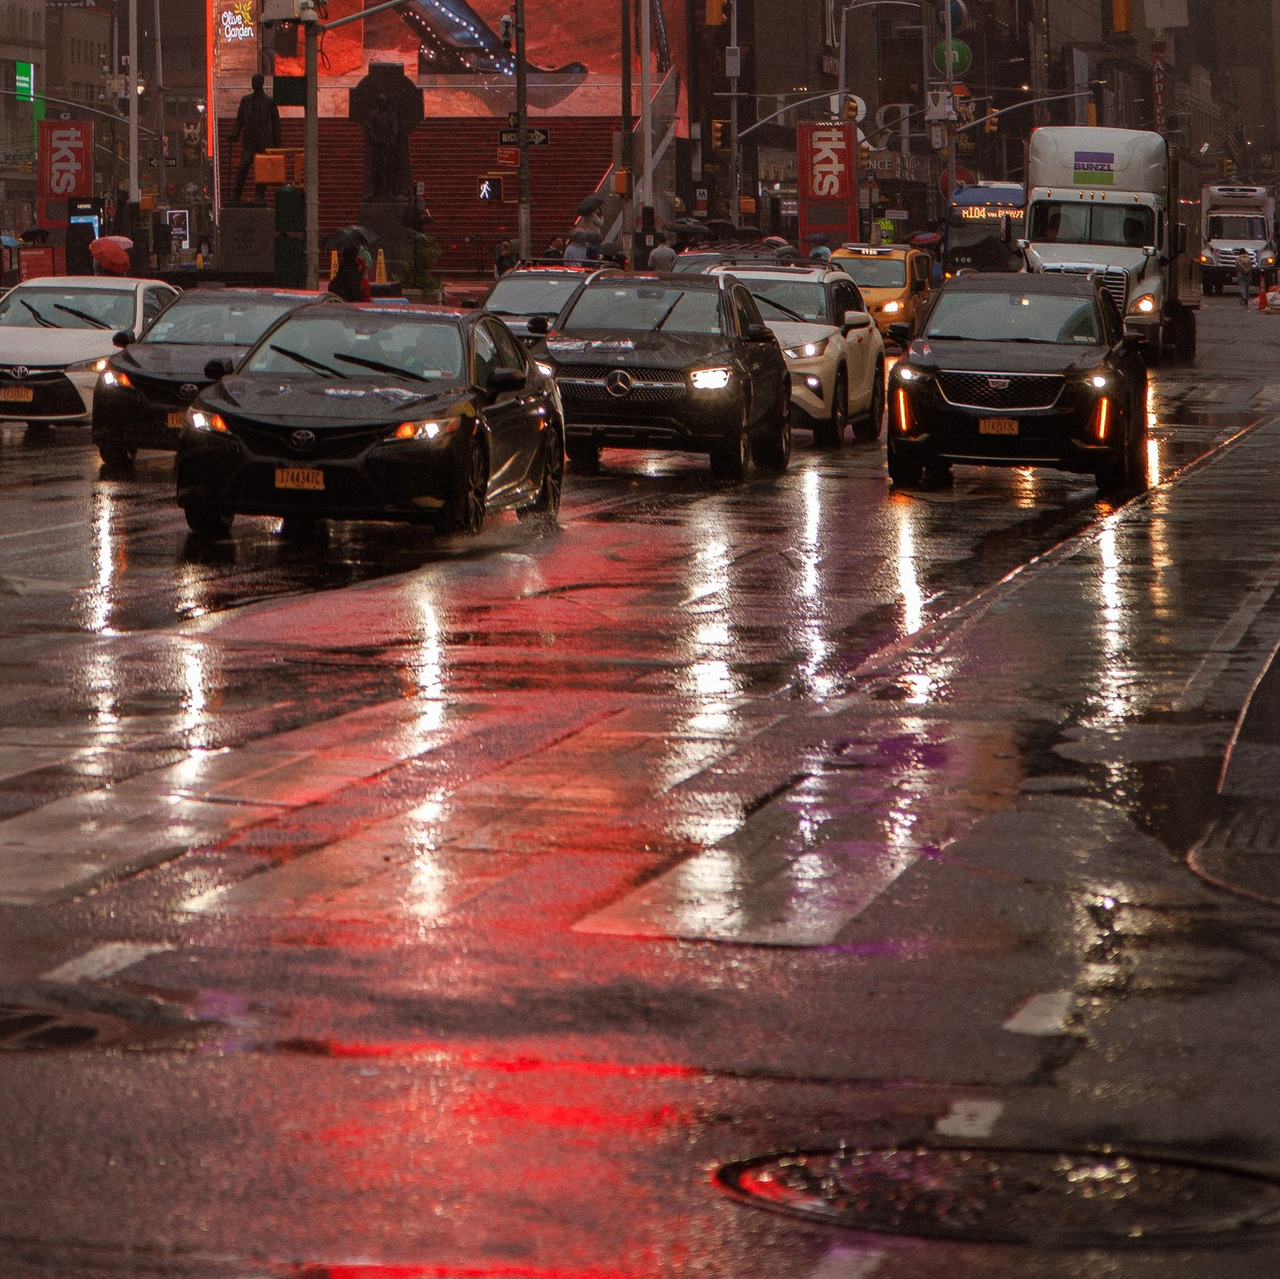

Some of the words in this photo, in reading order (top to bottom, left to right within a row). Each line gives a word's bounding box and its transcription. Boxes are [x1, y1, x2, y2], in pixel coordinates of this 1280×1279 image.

[222, 12, 242, 26] Olive
[223, 25, 254, 42] Garden
[51, 128, 83, 194] tkts
[812, 129, 846, 197] tkts
[1074, 163, 1114, 172] BUNZL
